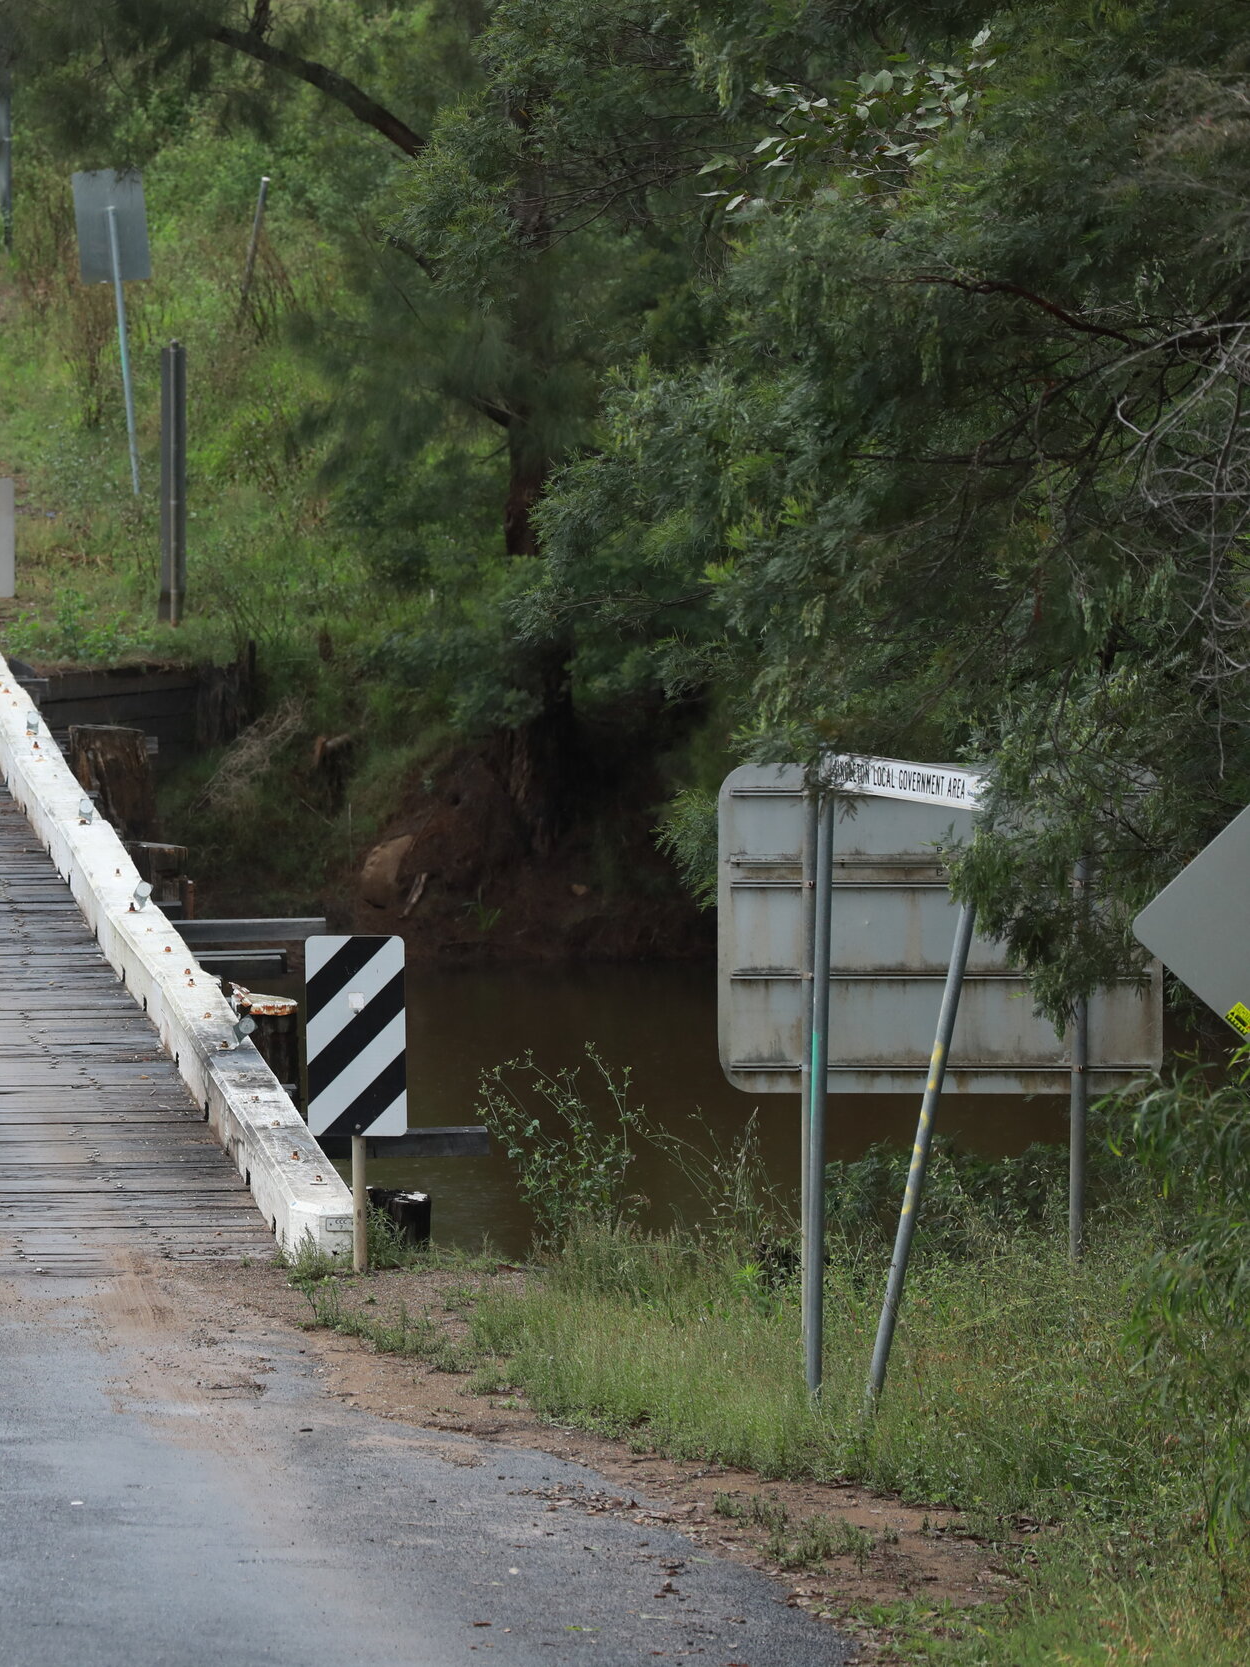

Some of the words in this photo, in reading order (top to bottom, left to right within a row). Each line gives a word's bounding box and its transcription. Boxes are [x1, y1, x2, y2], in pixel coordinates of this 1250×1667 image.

[873, 766, 895, 788] LOCAL
[898, 769, 944, 796] GOVERNMENT
[947, 777, 965, 799] AREA
